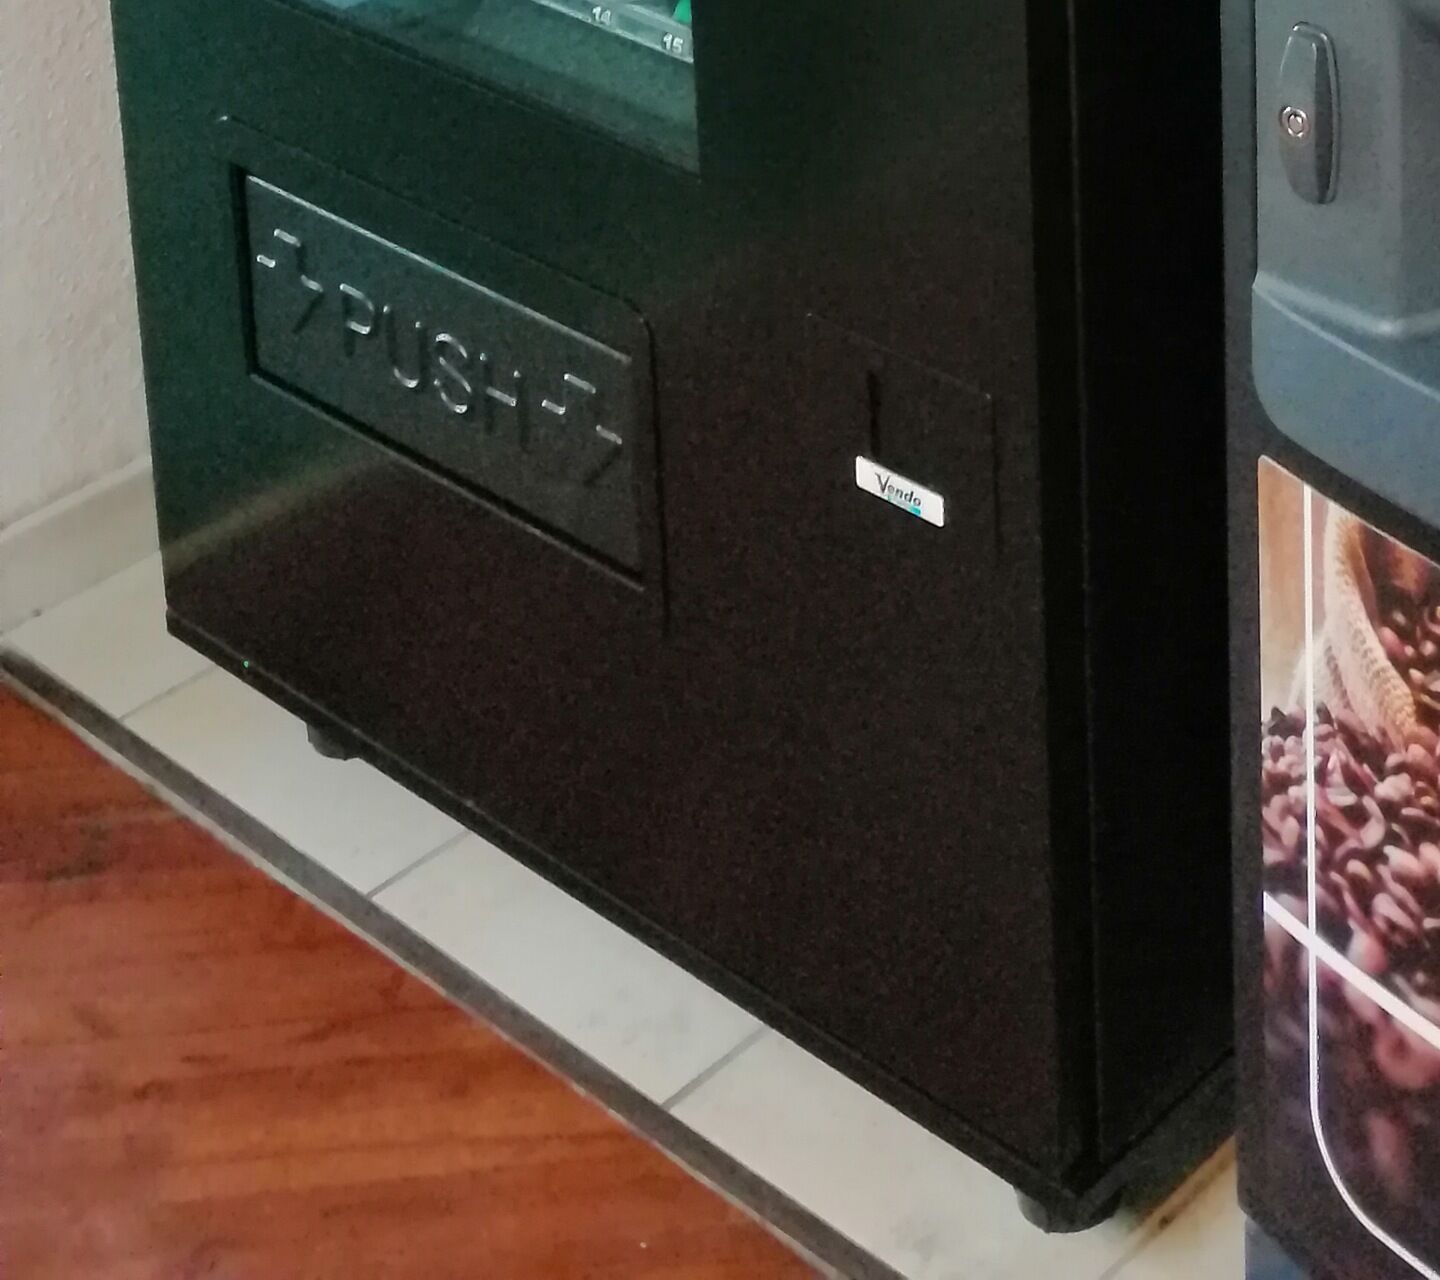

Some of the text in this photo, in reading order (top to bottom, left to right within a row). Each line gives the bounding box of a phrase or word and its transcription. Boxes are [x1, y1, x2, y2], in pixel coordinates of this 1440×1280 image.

[592, 6, 611, 25] 14
[663, 33, 683, 53] 15
[339, 282, 530, 454] PUSH
[875, 472, 921, 506] Vendo
